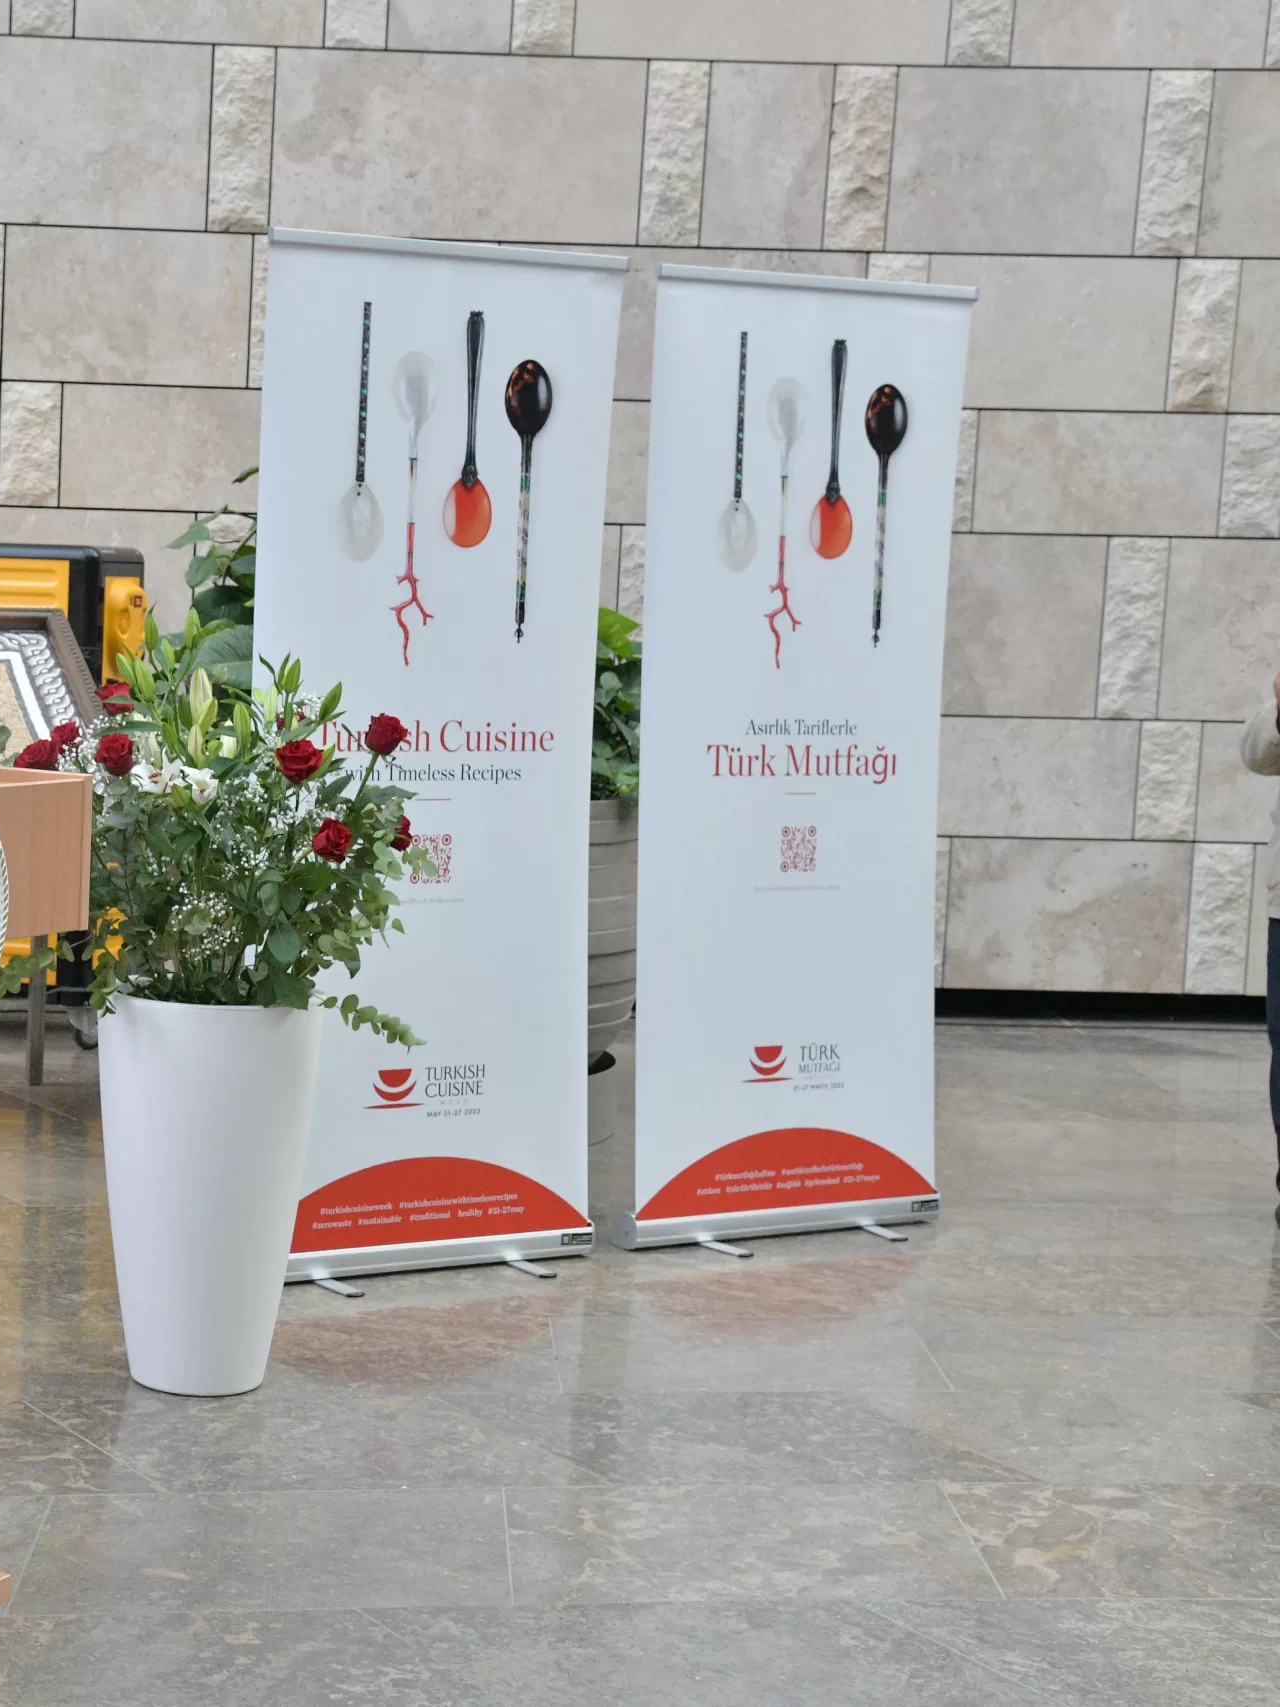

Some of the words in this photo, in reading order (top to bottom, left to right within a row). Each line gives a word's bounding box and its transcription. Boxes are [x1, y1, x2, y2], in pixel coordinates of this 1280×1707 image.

[321, 719, 431, 752] Tursh
[440, 719, 554, 753] Cuisine
[745, 719, 791, 736] Asırlık
[794, 719, 858, 736] Tariflerle
[706, 743, 777, 777] Türk
[784, 743, 897, 785] Mutfağı
[386, 764, 455, 781] Timeless
[461, 764, 521, 785] Recipes
[799, 1041, 840, 1061] TÜRK
[424, 1064, 485, 1081] TURKISH
[798, 1061, 841, 1074] MUTFAĞI
[424, 1080, 484, 1098] CUISINE
[444, 1109, 462, 1117] 21-27
[464, 1108, 481, 1116] 2023
[320, 1202, 393, 1216] #turkishcuisineweek
[399, 1192, 518, 1209] #turkishcuisinewithtimelessrecipes
[312, 1219, 353, 1230] #zerowaste
[358, 1214, 402, 1226] #sustainable
[410, 1210, 451, 1222] #traditional
[458, 1208, 483, 1219] healthy
[487, 1205, 524, 1216] #21-27may
